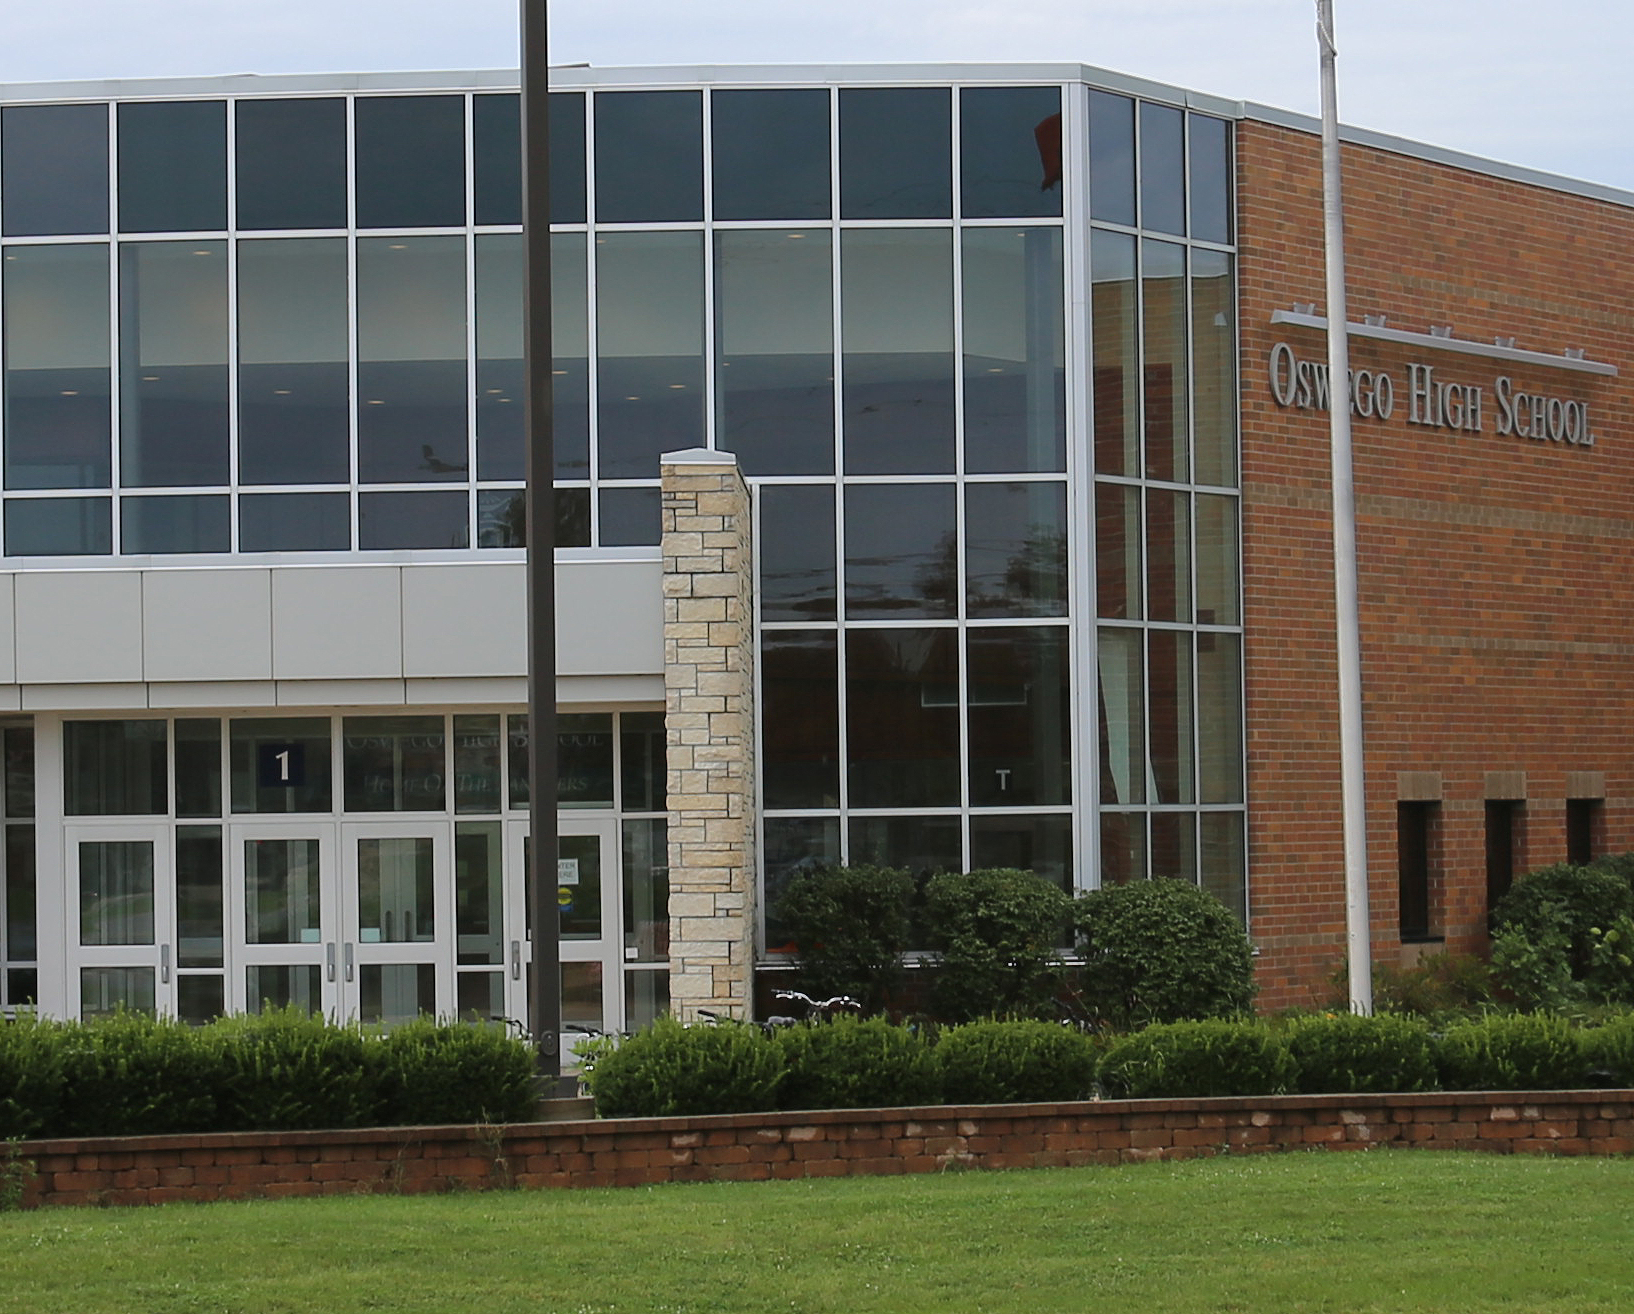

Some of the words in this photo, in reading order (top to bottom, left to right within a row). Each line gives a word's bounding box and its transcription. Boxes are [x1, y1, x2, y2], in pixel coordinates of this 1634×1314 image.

[1406, 363, 1482, 432] HIGH
[1495, 376, 1595, 446] SCHOOL
[275, 751, 289, 780] 1
